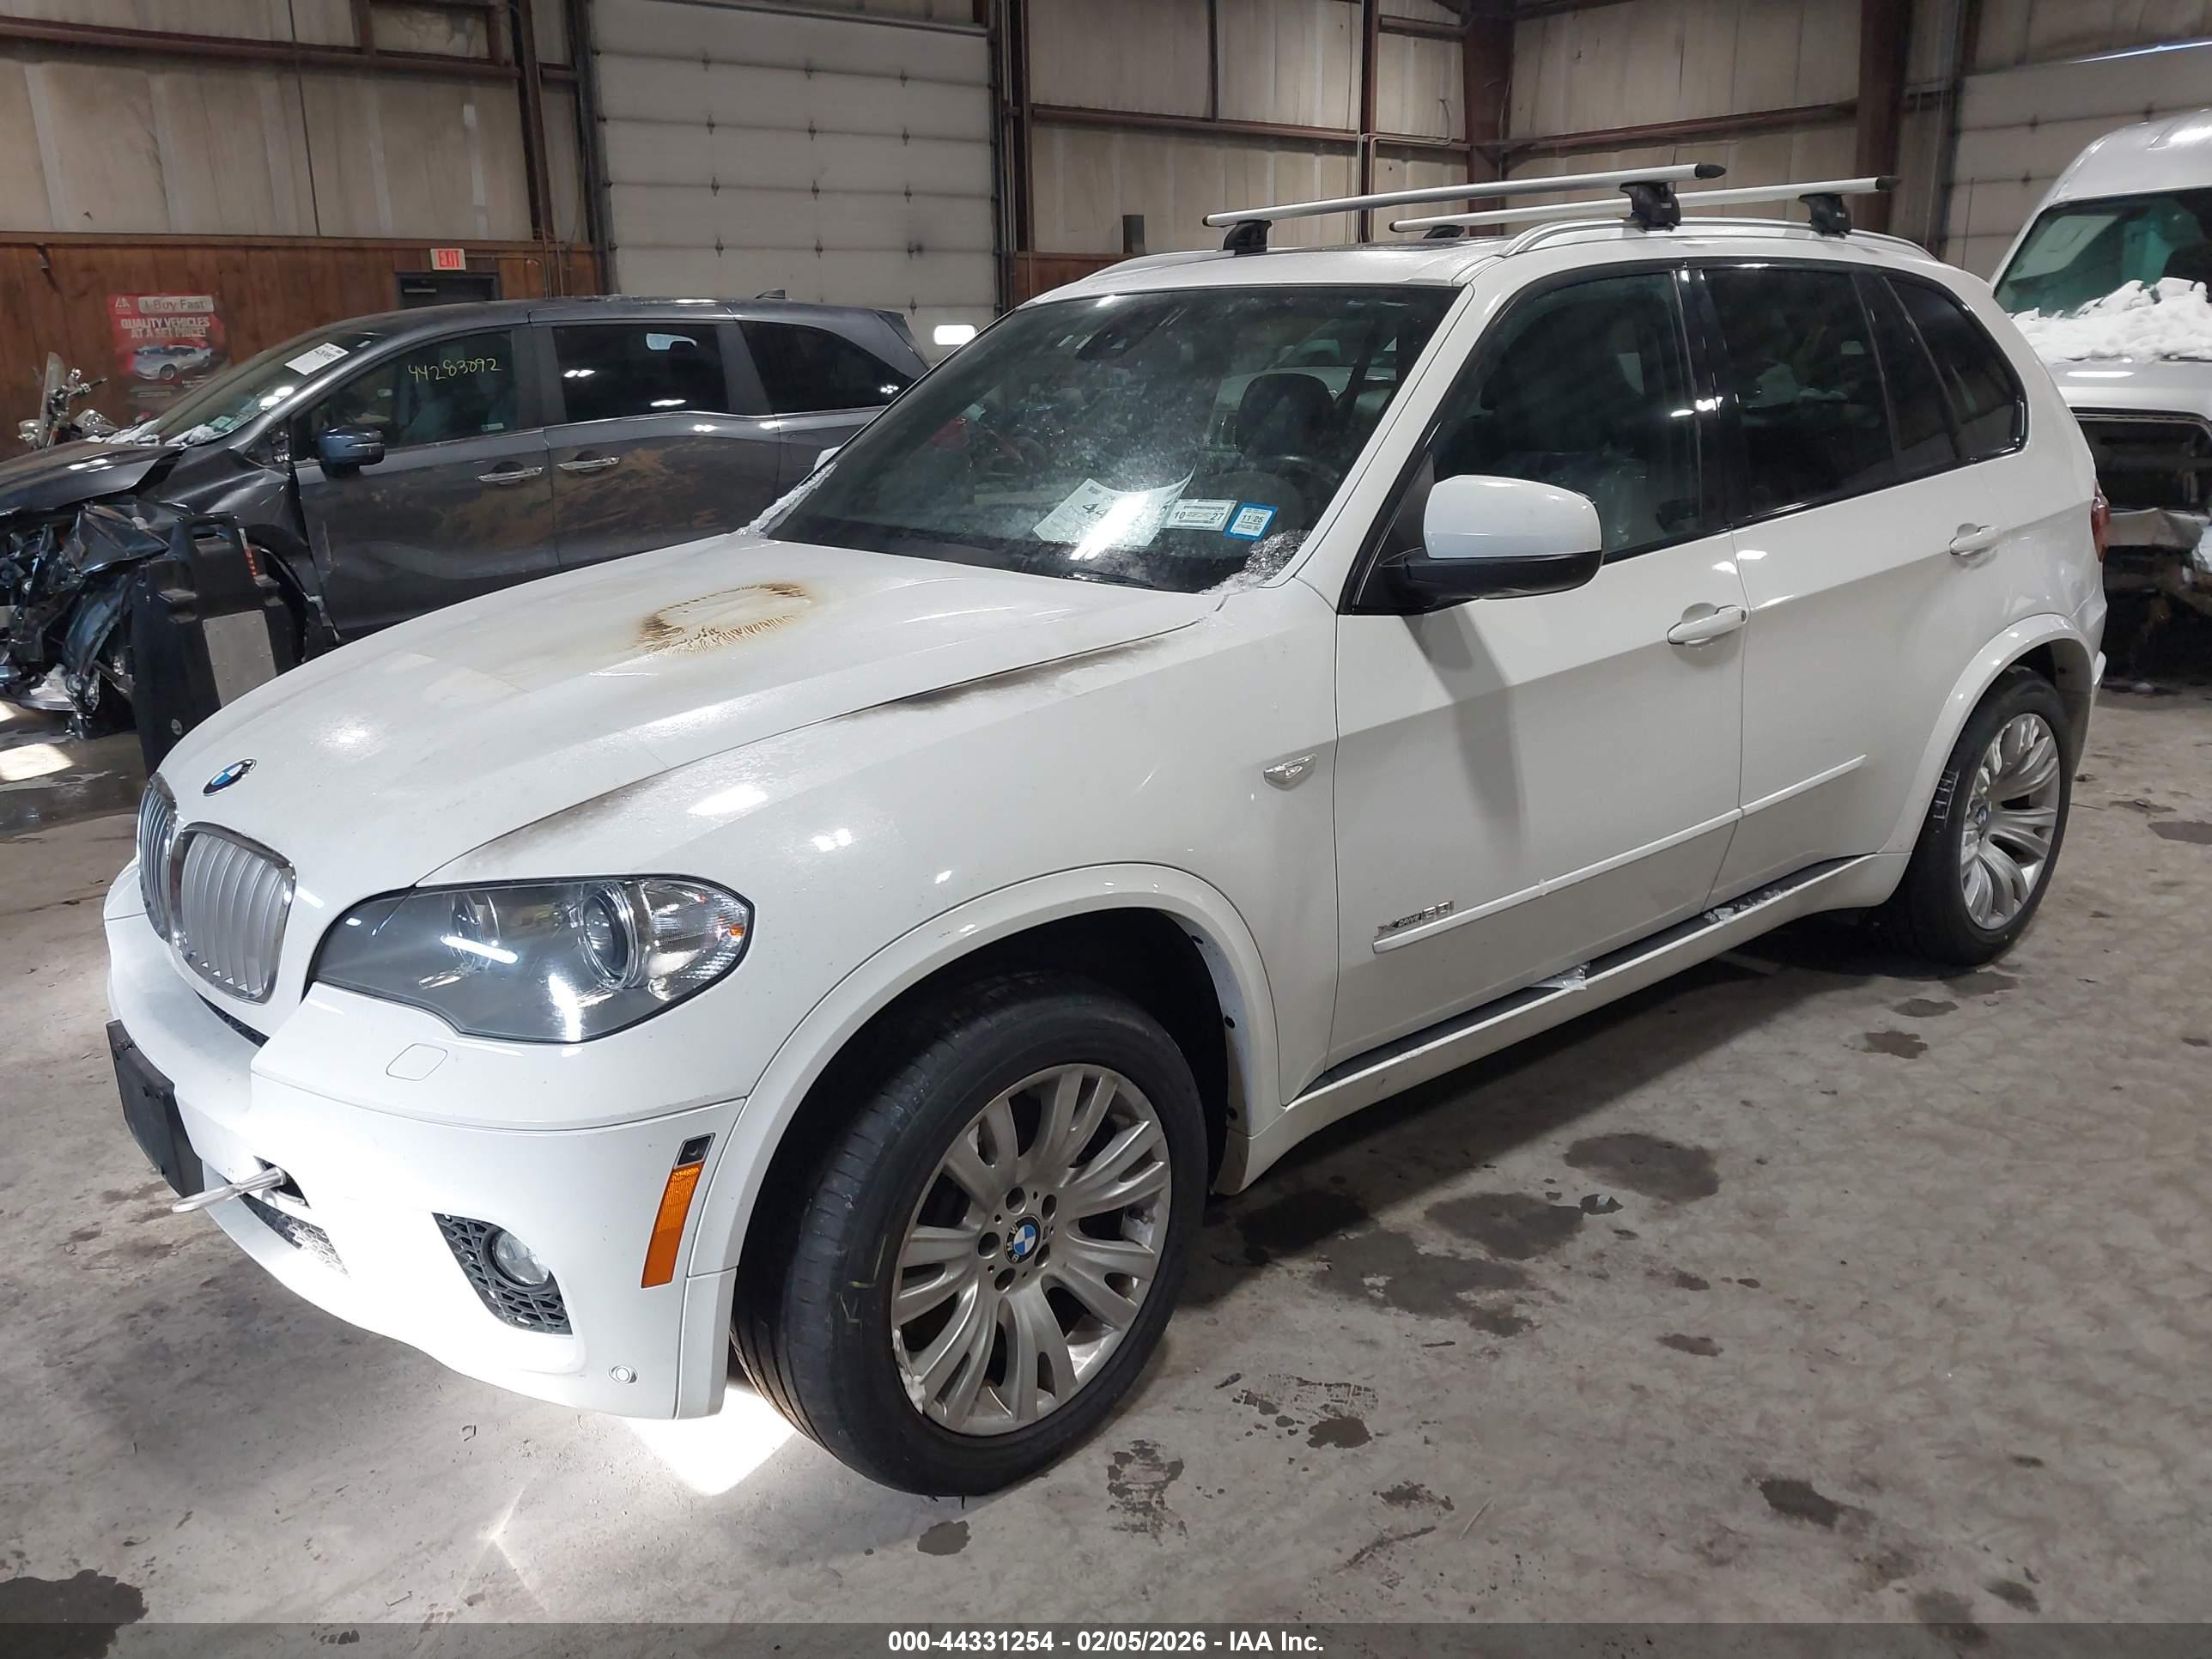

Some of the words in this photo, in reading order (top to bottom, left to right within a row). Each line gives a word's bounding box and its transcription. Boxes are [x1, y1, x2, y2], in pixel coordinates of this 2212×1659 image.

[179, 299, 205, 310] Fast
[121, 318, 161, 329] QUALITY
[163, 317, 210, 328] VEHICLES
[131, 328, 143, 338] AT
[145, 328, 153, 337] A
[408, 358, 501, 384] 44283092
[1174, 511, 1186, 520] 10
[1210, 512, 1224, 521] 27
